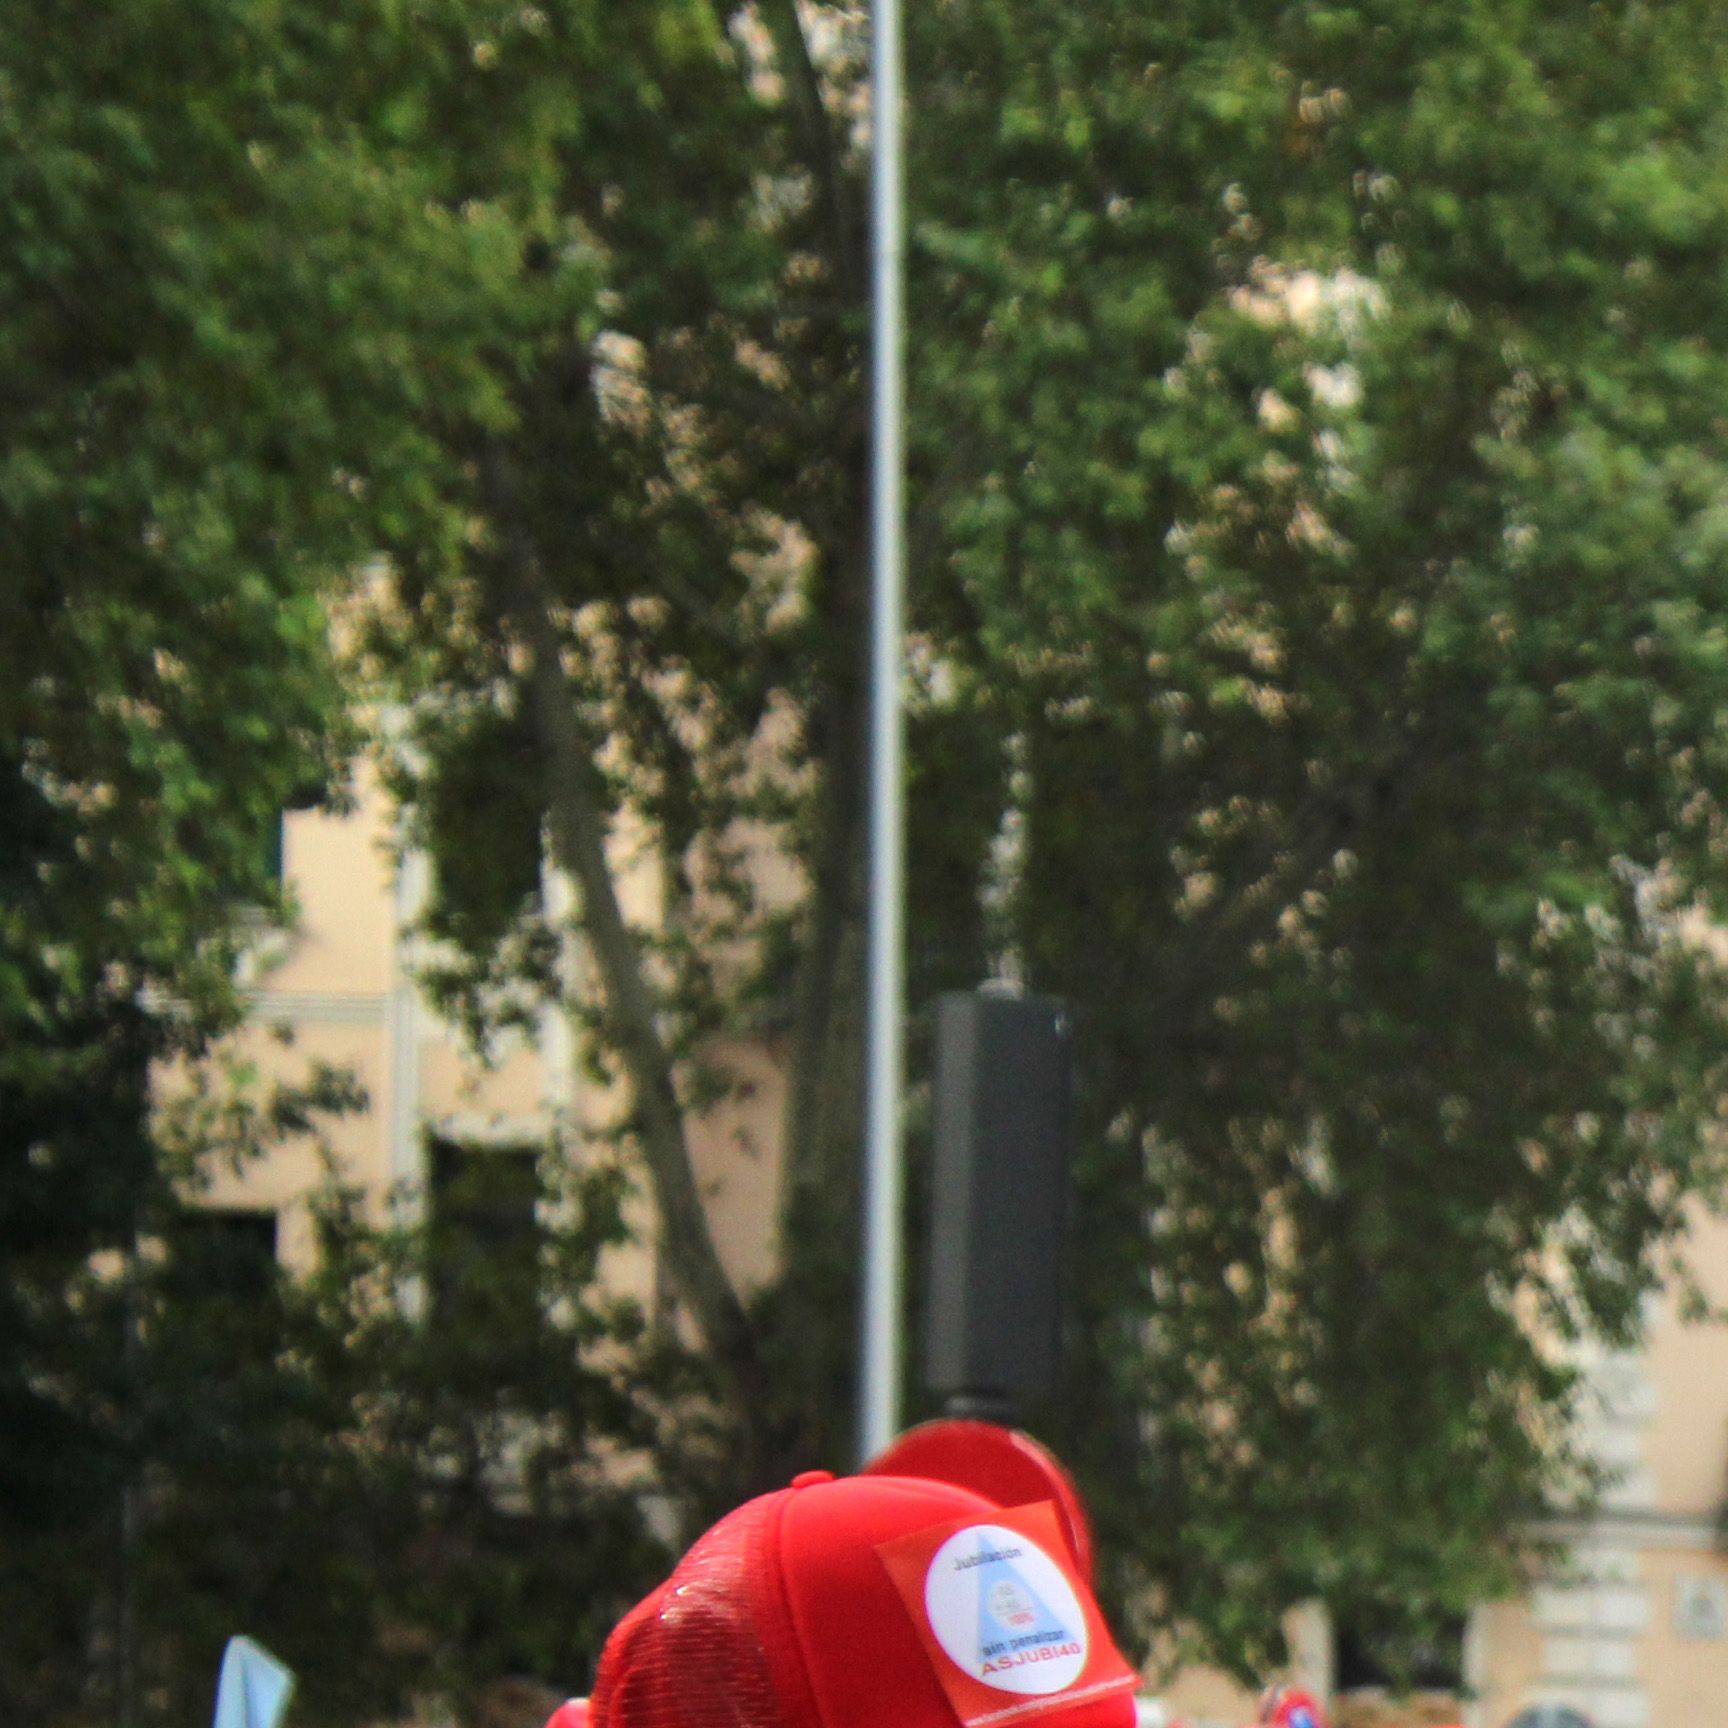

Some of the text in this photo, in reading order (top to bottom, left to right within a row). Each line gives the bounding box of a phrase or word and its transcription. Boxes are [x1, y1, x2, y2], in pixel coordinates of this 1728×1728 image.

[952, 1546, 1024, 1573] Jubilación
[982, 1628, 1065, 1657] sin penalizar
[980, 1641, 1082, 1677] ASJUBI40
